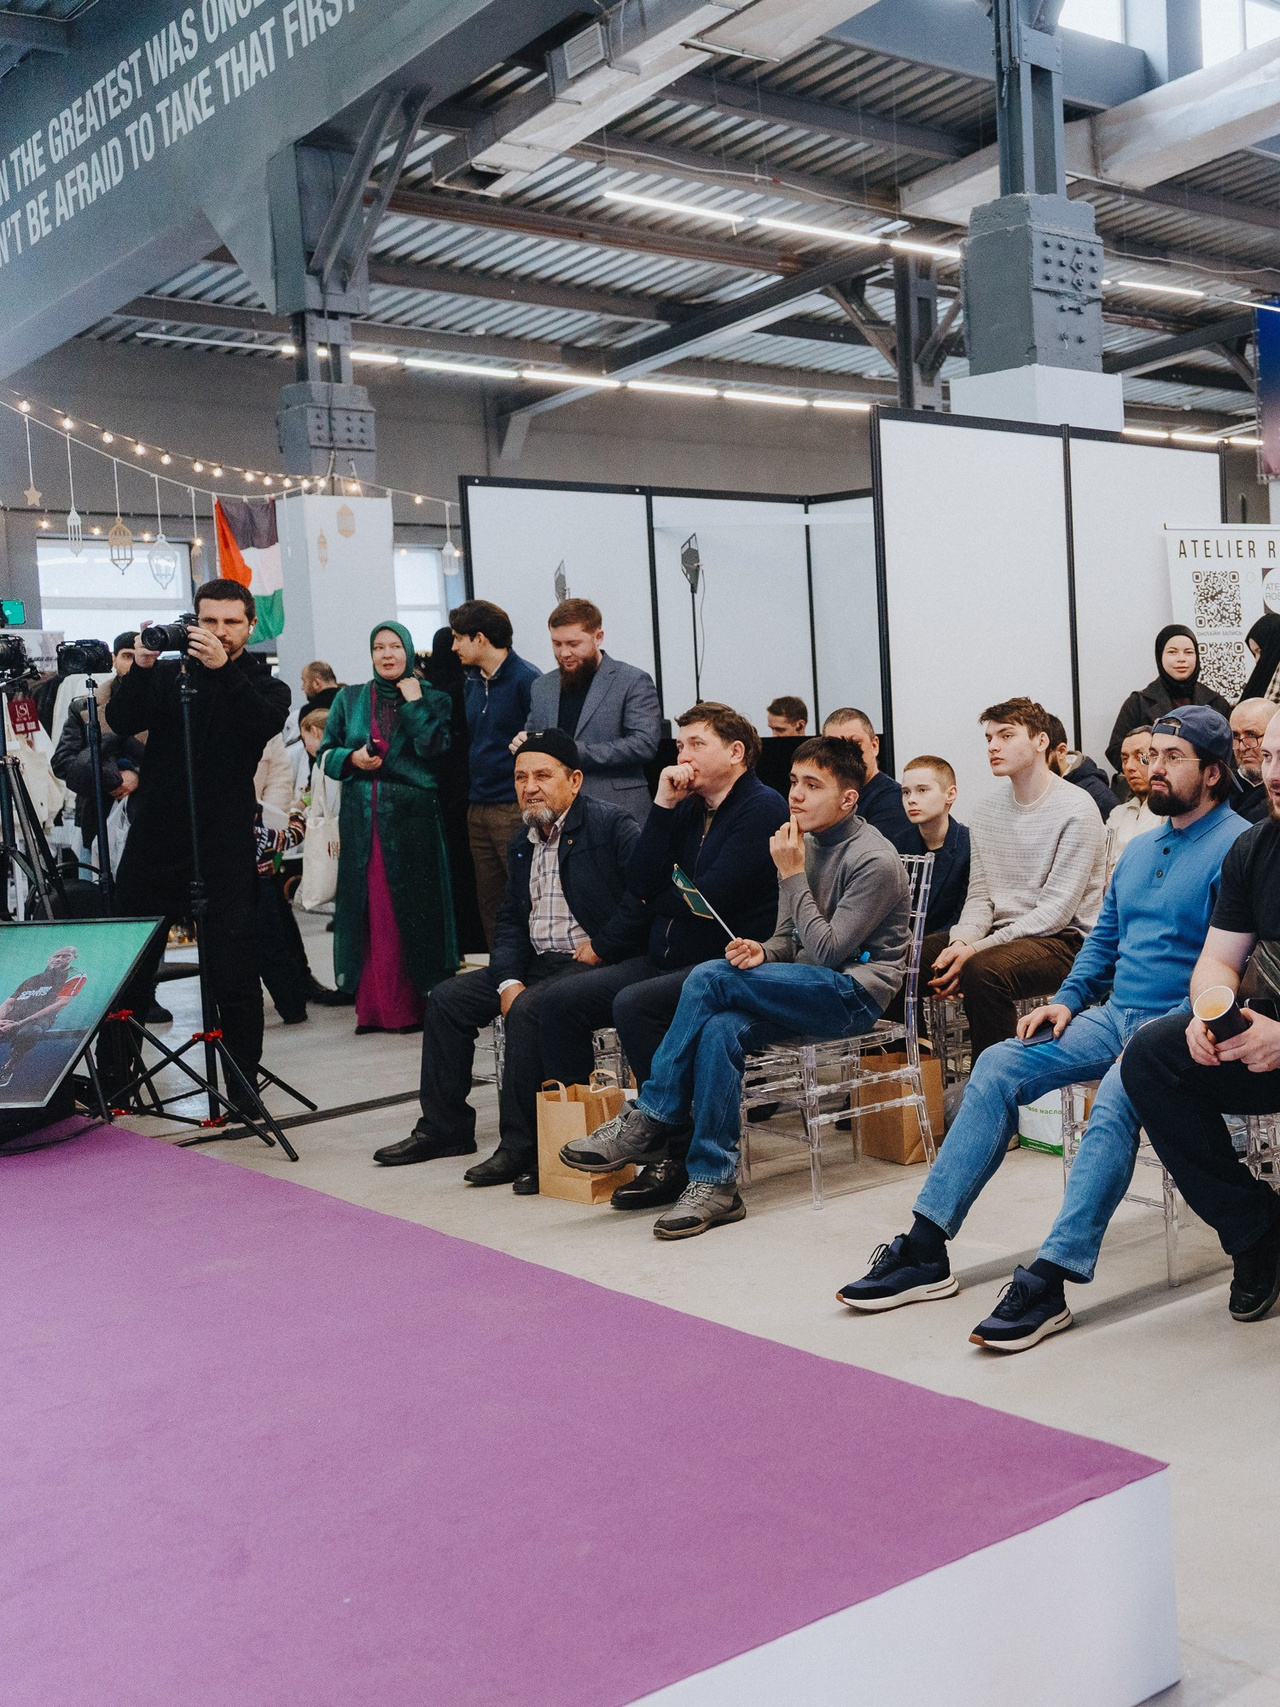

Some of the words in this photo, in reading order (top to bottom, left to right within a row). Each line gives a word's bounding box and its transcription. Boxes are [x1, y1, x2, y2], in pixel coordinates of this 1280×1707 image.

[10, 129, 47, 193] THE
[48, 47, 143, 165] GREATEST
[145, 7, 198, 87] WAS
[202, 0, 265, 44] ON
[25, 190, 53, 246] BE
[55, 136, 124, 228] AFRAID
[125, 112, 155, 171] TO
[155, 66, 216, 149] TAKE
[215, 16, 276, 106] THAT
[283, 0, 355, 59] FIRS
[1178, 539, 1257, 559] ATELIER
